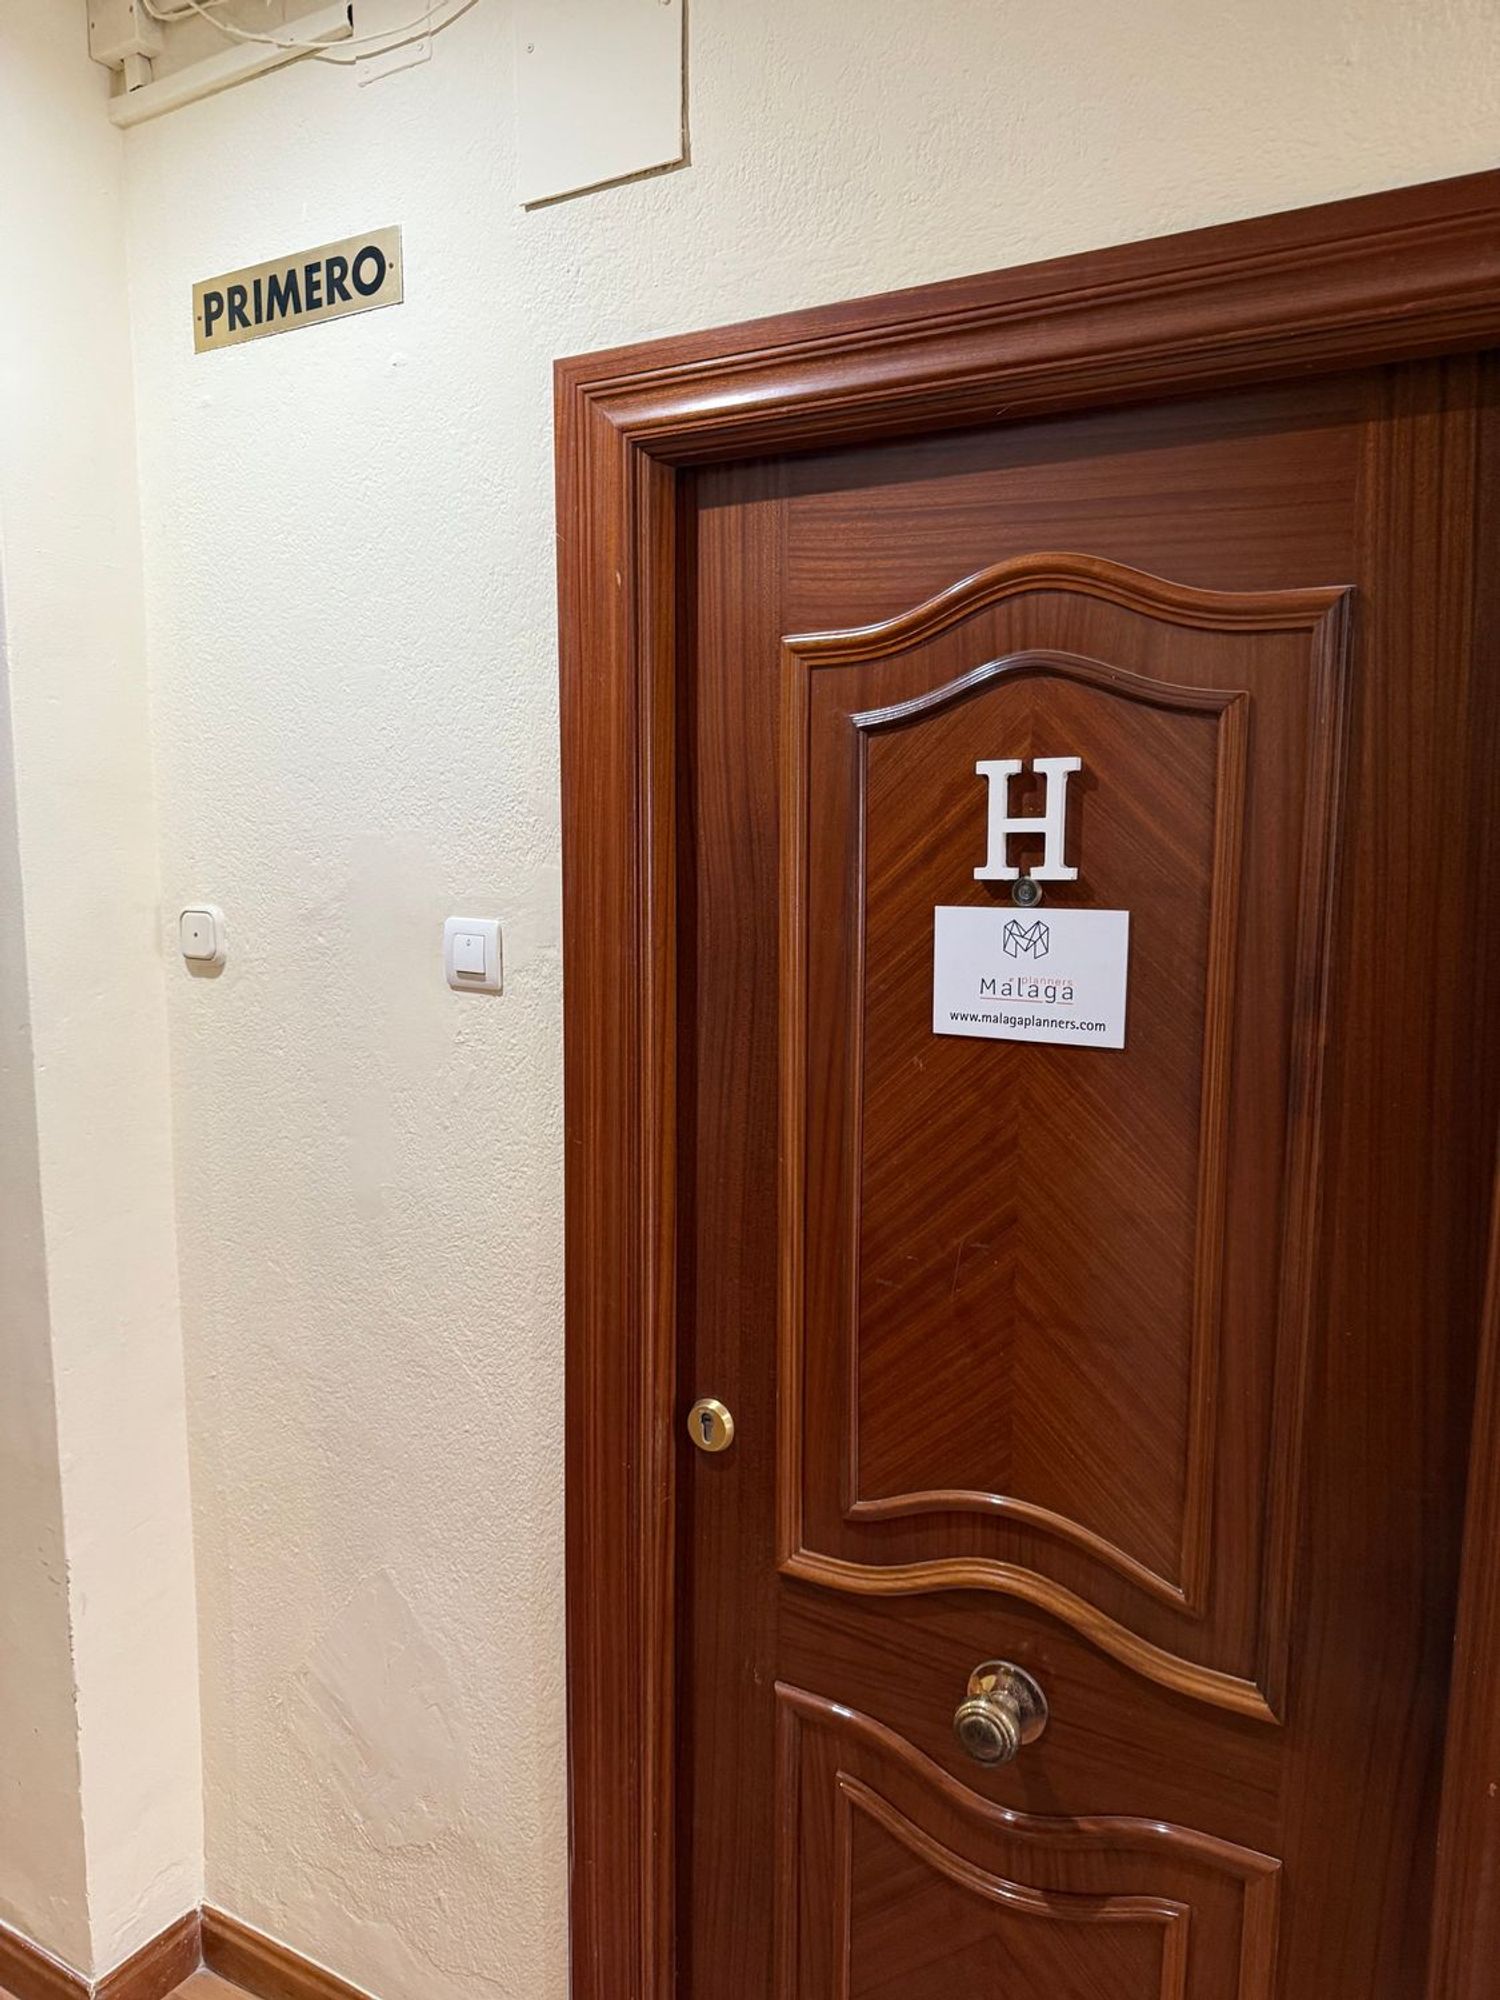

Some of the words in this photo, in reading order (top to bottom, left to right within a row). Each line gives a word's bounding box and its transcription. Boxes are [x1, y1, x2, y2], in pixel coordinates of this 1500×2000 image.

[204, 246, 386, 337] PRIMERO
[973, 757, 1081, 880] H
[1021, 976, 1073, 987] planners
[949, 1010, 1106, 1032] www.malagaplanners.com
